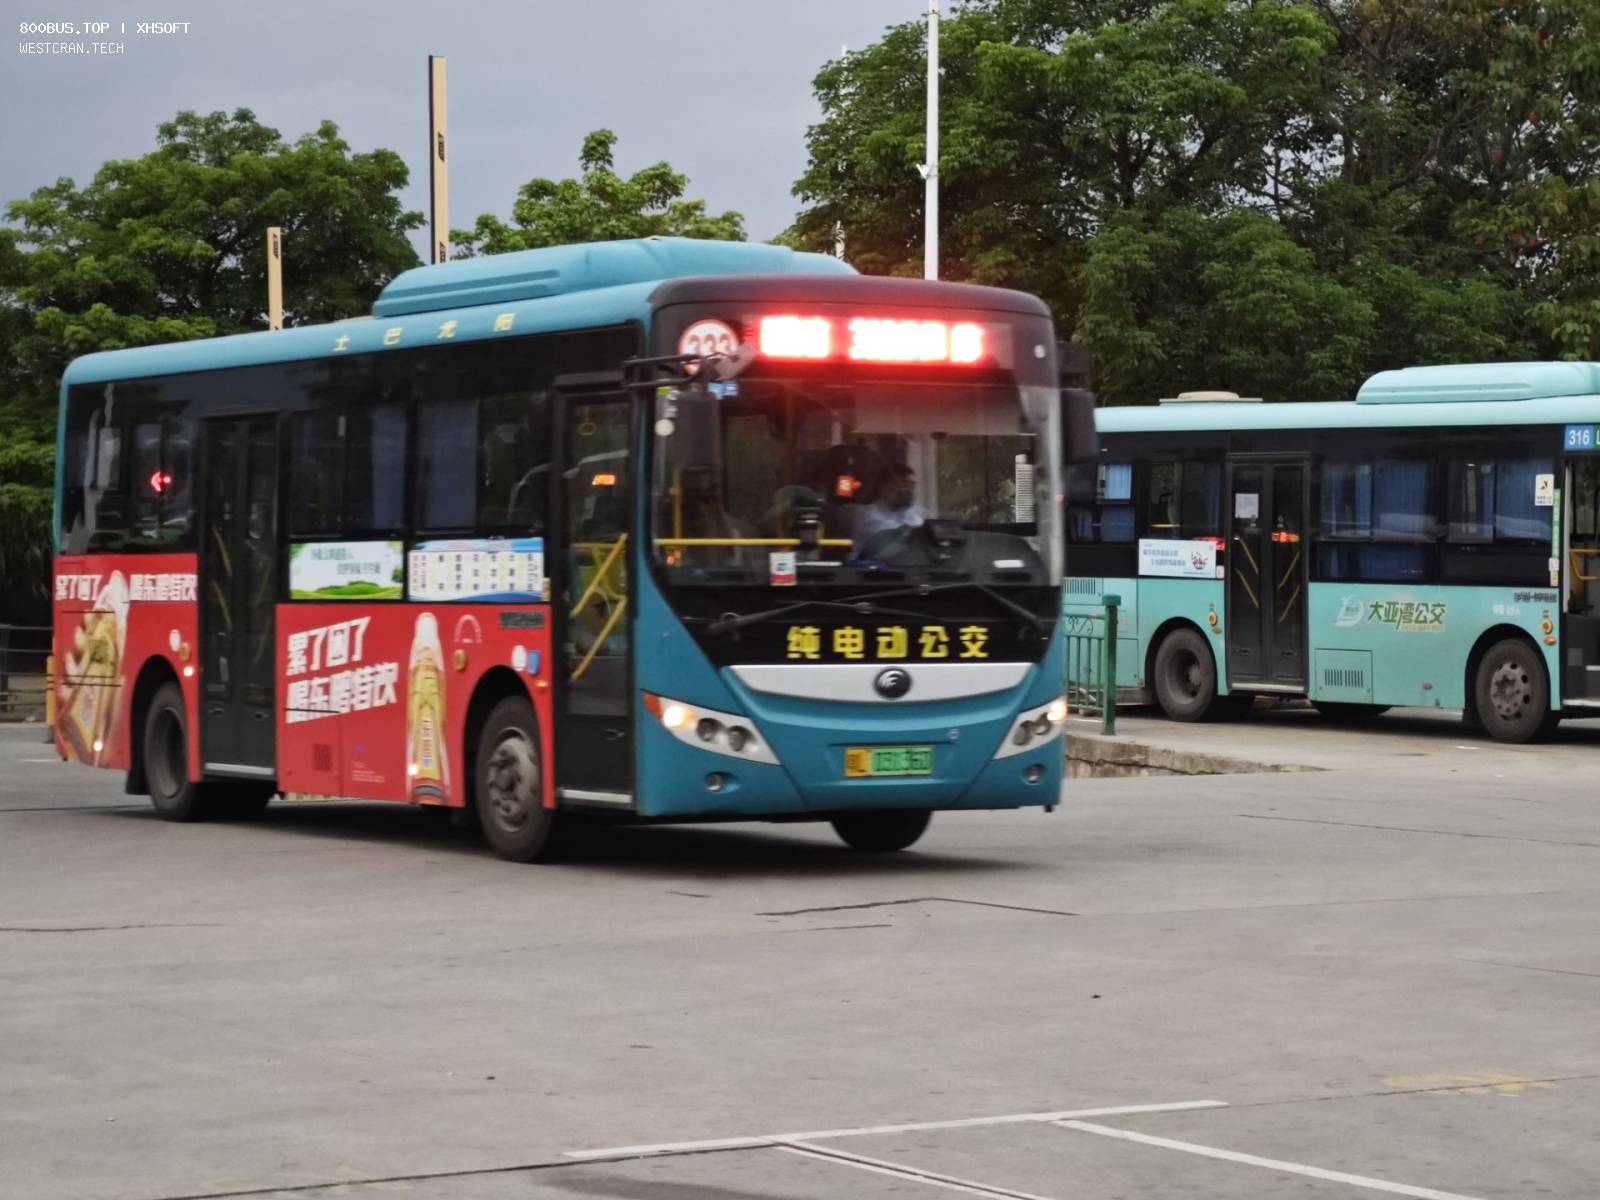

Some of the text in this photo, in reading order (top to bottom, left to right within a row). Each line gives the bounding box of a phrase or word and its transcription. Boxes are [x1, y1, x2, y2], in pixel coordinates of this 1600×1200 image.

[1569, 429, 1590, 445] 316
[1368, 601, 1446, 630] 大亚湾公交
[286, 616, 371, 676] 累了困了
[786, 626, 989, 659] 纯电动公交
